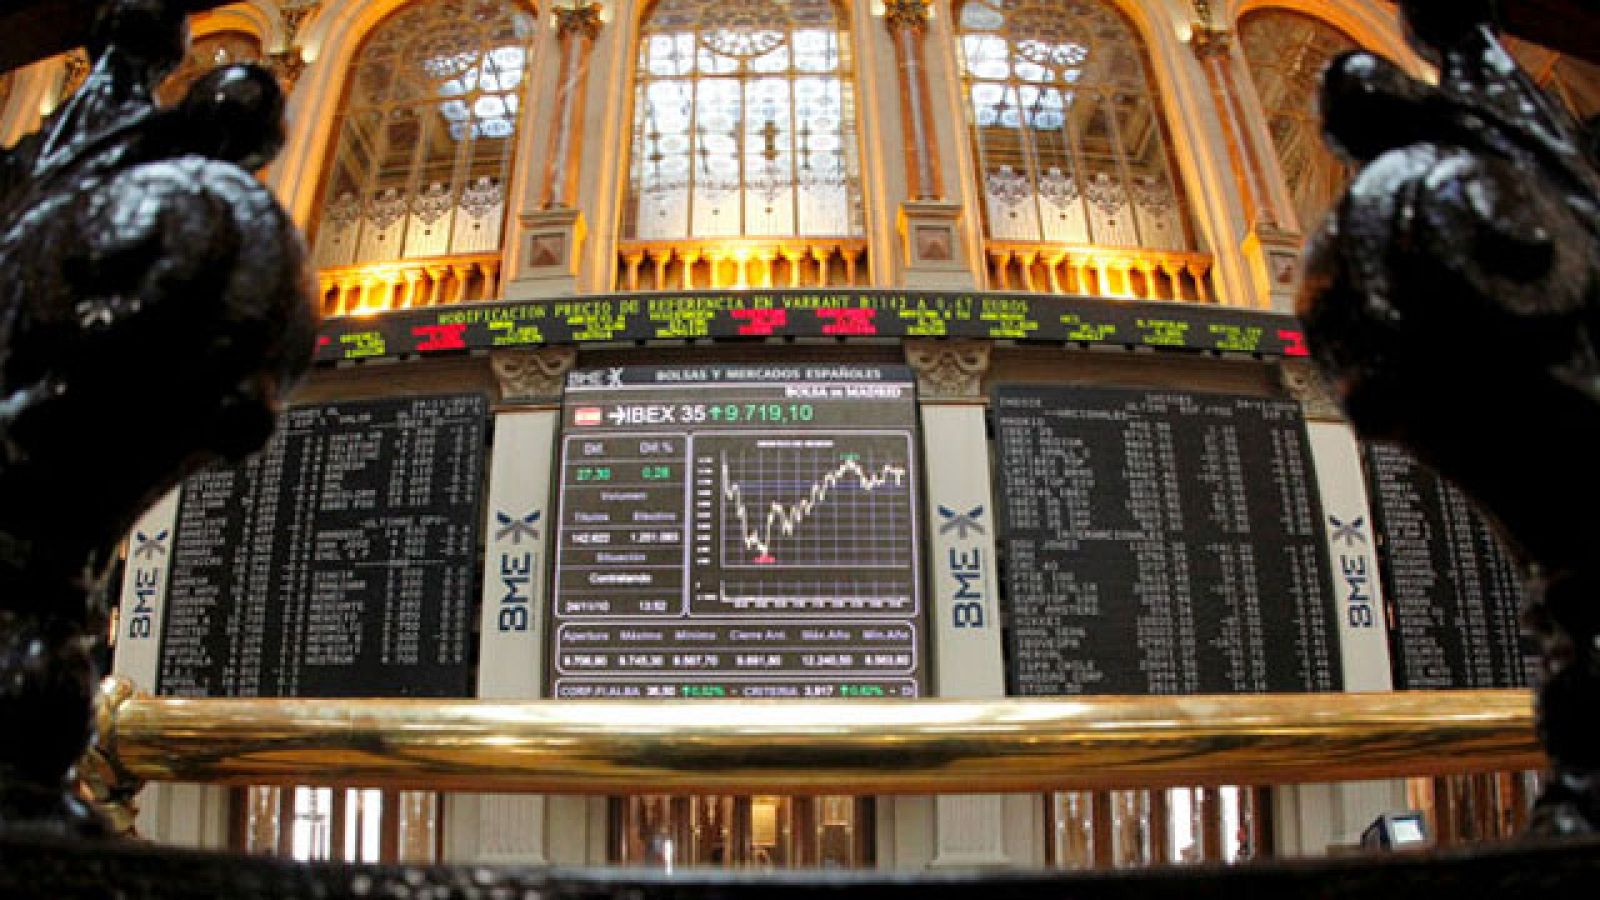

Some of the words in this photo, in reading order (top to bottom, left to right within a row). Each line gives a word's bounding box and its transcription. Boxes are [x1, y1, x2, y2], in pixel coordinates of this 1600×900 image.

[655, 369, 706, 382] BOLSAS
[712, 369, 721, 381] Y
[725, 369, 801, 381] MERCADOS
[804, 366, 881, 381] ESPAÑOLES
[846, 385, 902, 399] MADRID
[625, 404, 676, 424] IBEX
[681, 404, 706, 424] 35
[723, 404, 814, 426] 9.719,10
[129, 566, 159, 640] BME
[499, 551, 532, 633] BME
[950, 546, 984, 629] BME
[1341, 554, 1372, 629] BME
